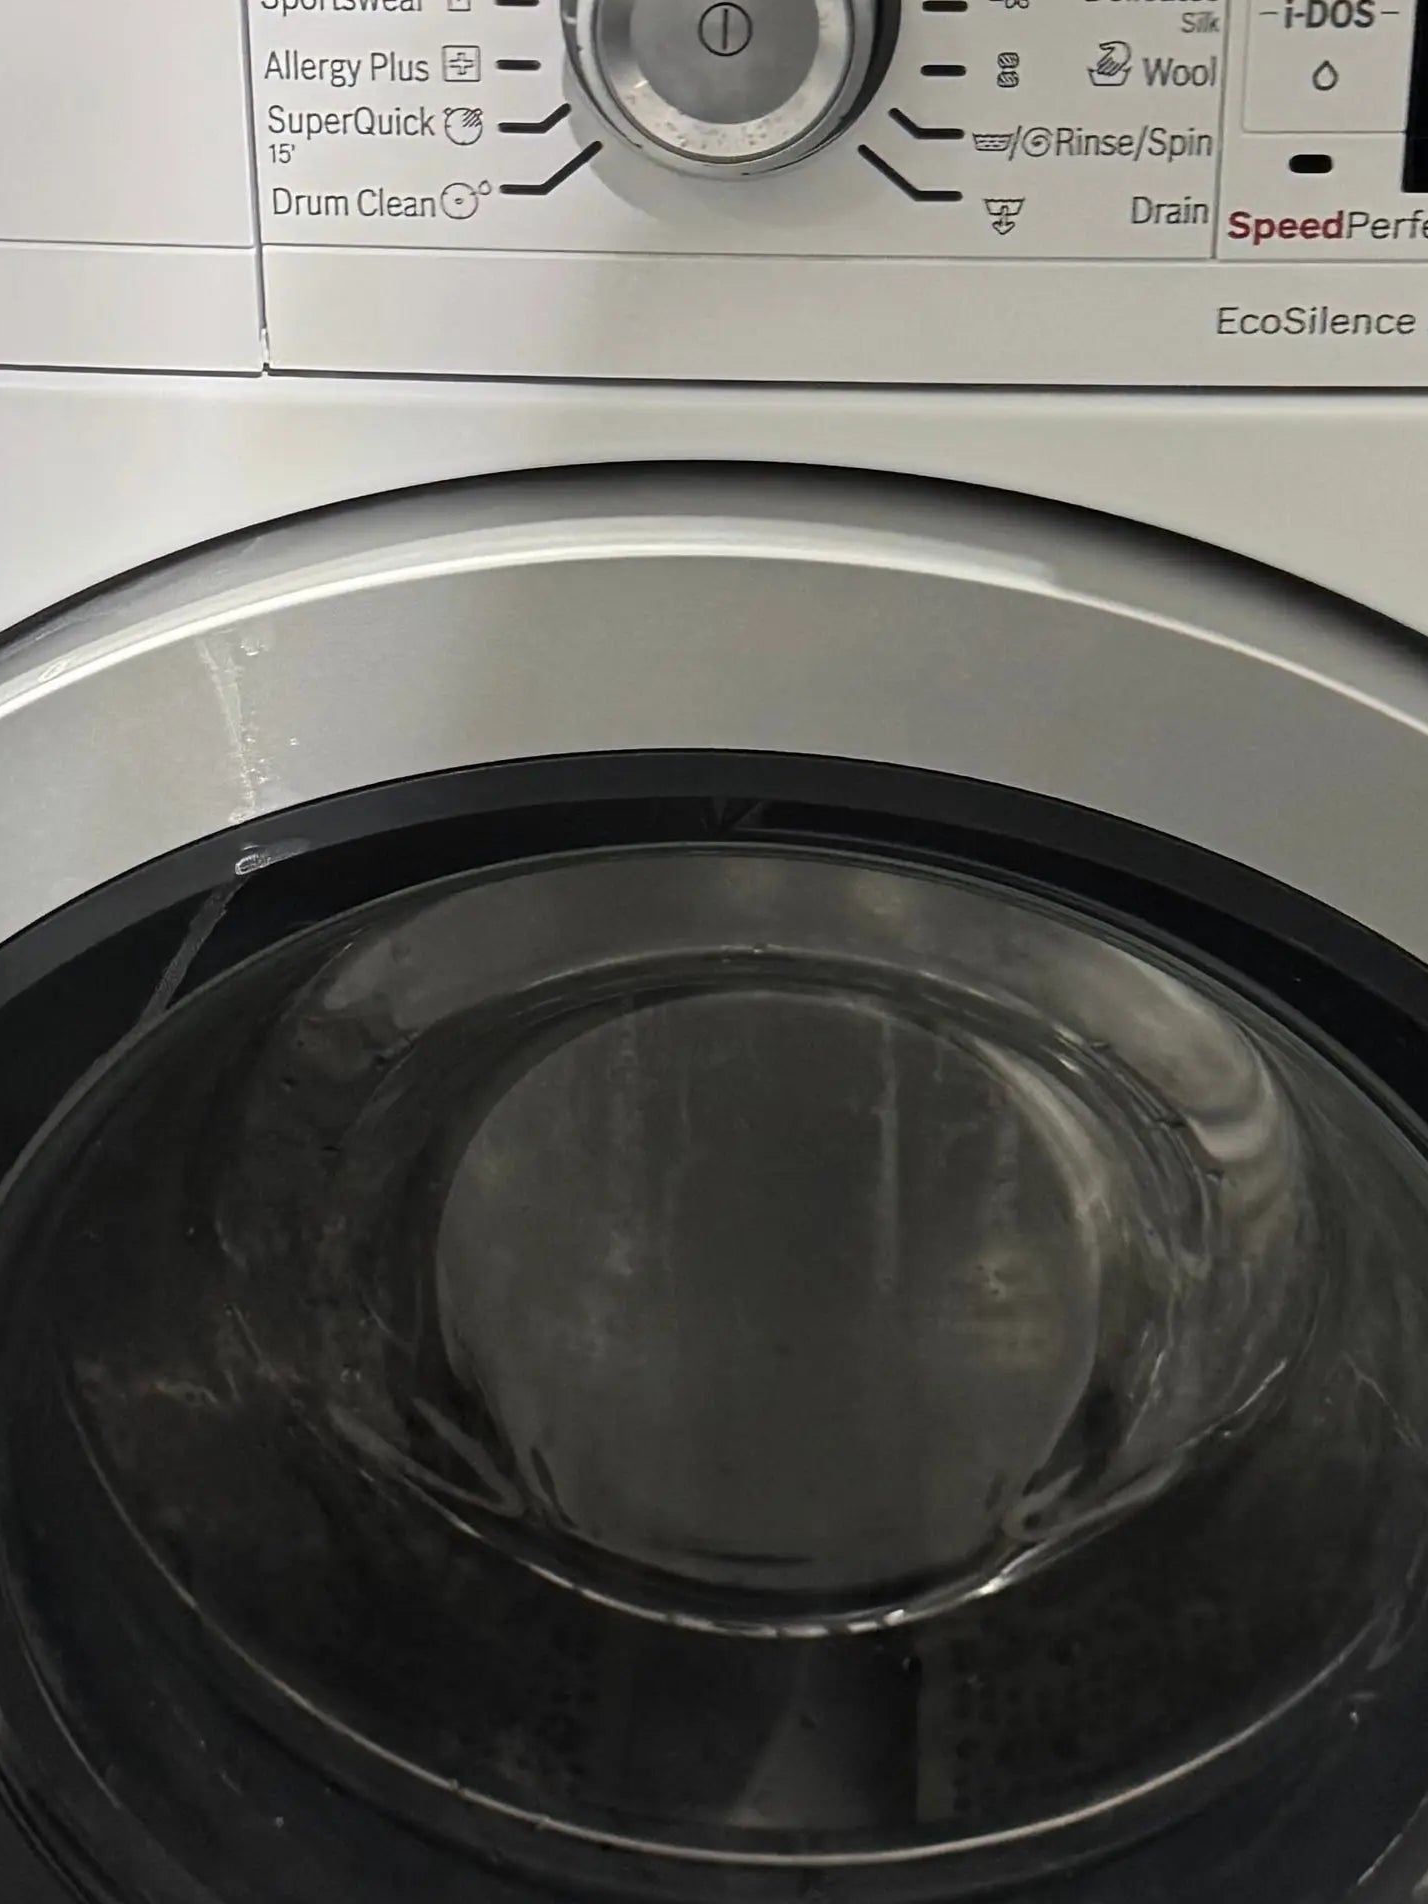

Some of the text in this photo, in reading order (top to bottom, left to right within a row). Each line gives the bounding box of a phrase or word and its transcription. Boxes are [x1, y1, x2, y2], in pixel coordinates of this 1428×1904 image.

[1180, 12, 1220, 33] Silk
[264, 50, 430, 88] Allergy Plus
[1142, 56, 1217, 87] Wool
[268, 104, 436, 140] SuperQuick
[1054, 128, 1213, 161] Rinse/Spin
[272, 187, 436, 219] Drum Clean
[1131, 195, 1210, 226] Drain
[1216, 306, 1417, 336] EcoSilence
